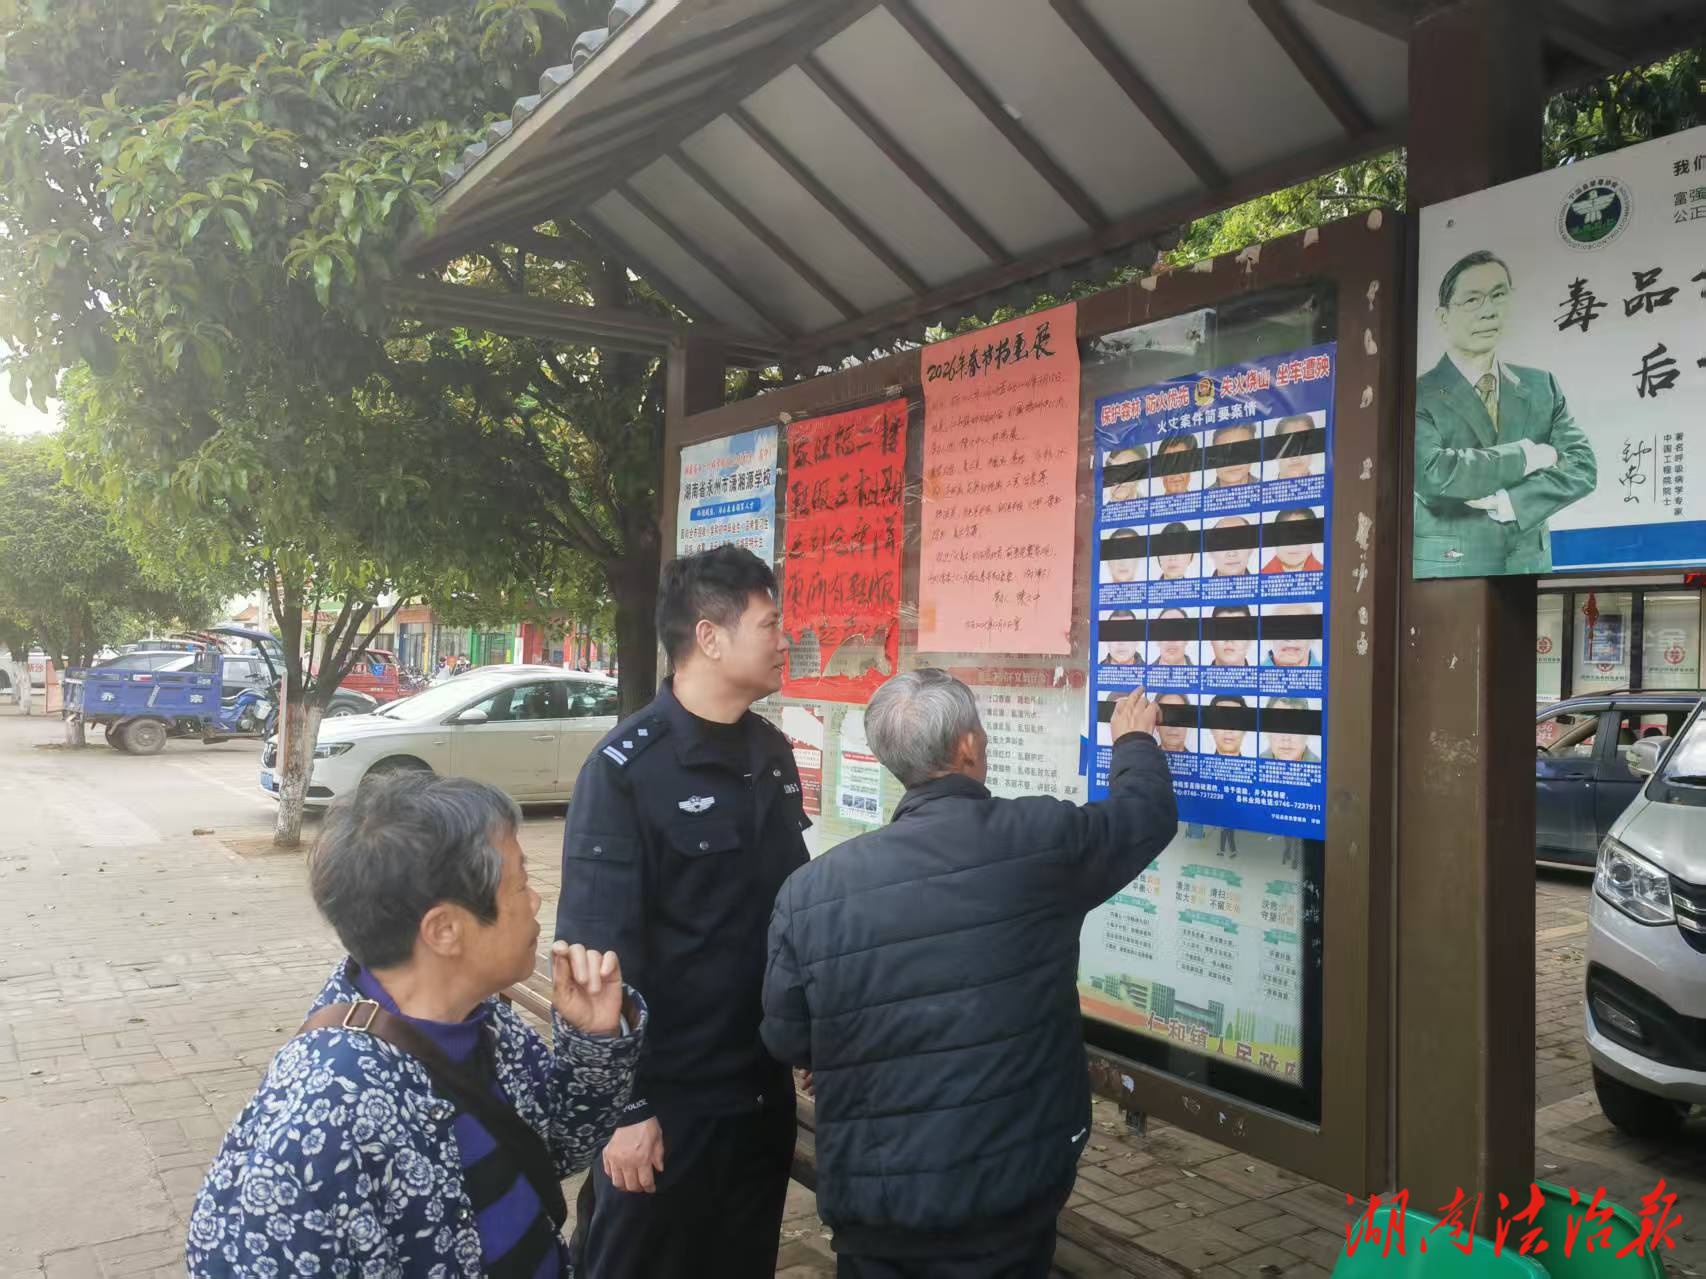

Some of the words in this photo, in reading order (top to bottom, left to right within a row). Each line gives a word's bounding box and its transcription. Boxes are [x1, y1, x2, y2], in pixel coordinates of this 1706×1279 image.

[1672, 206, 1706, 224] 公正
[1554, 264, 1706, 333] 毒品
[1100, 397, 1142, 426] 保护森林
[1144, 386, 1190, 416] 防火优先
[1219, 368, 1272, 398] 失火烧山
[1632, 342, 1706, 400] 后
[1662, 434, 1673, 506] 中国工程院院士
[1673, 432, 1685, 516] 著名呼吸病学专家
[623, 1098, 649, 1113] POLICE
